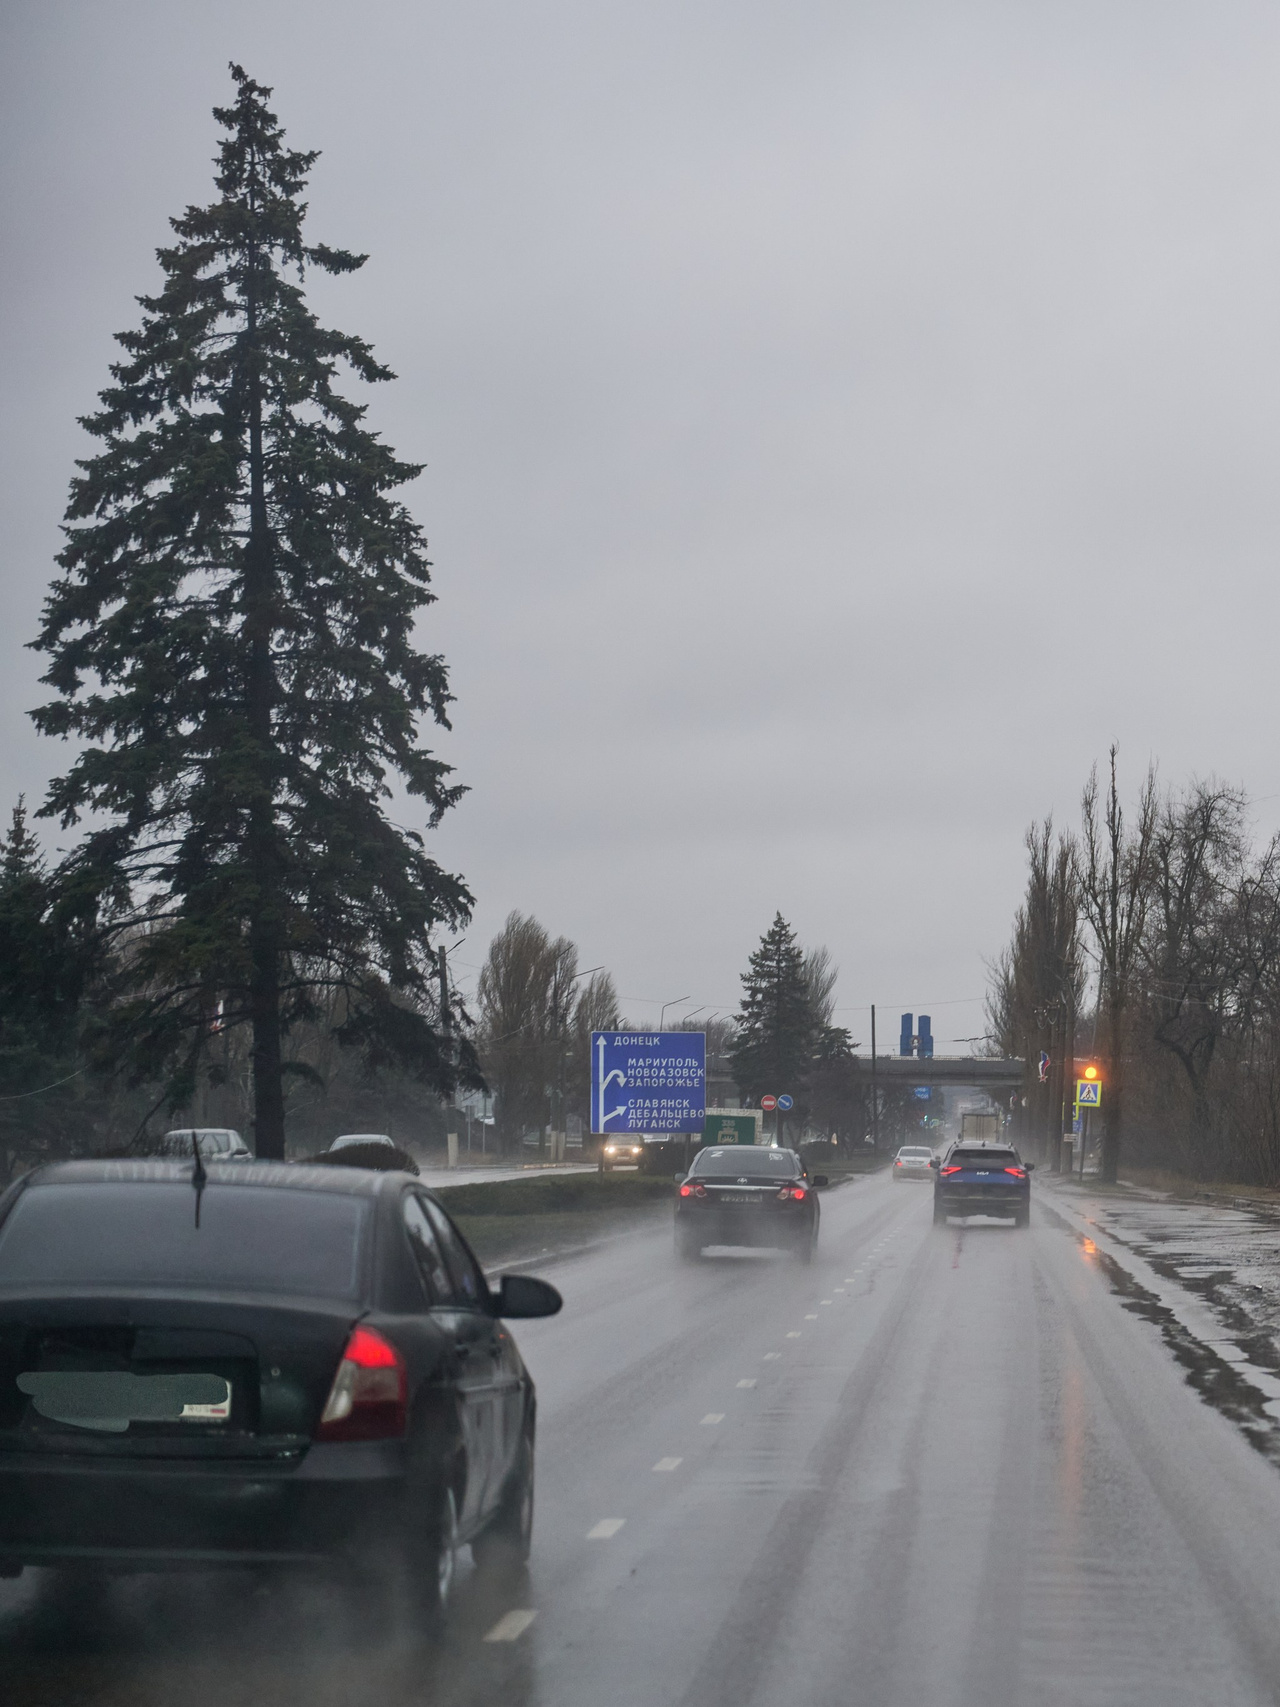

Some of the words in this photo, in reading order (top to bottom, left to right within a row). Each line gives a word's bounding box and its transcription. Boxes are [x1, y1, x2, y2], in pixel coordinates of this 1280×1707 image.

[613, 1036, 661, 1047] ДОНЕЦК
[627, 1058, 699, 1067] МАРИУПОЛЬ
[627, 1068, 704, 1077] НОВОАЗОВСК
[628, 1078, 700, 1087] ЗАПОРОЖЬЕ
[628, 1099, 690, 1108] СЛАВЯНСК
[628, 1109, 705, 1119] ДЕБАЛЬЦЕВО
[628, 1119, 681, 1128] ЛУГАНСК
